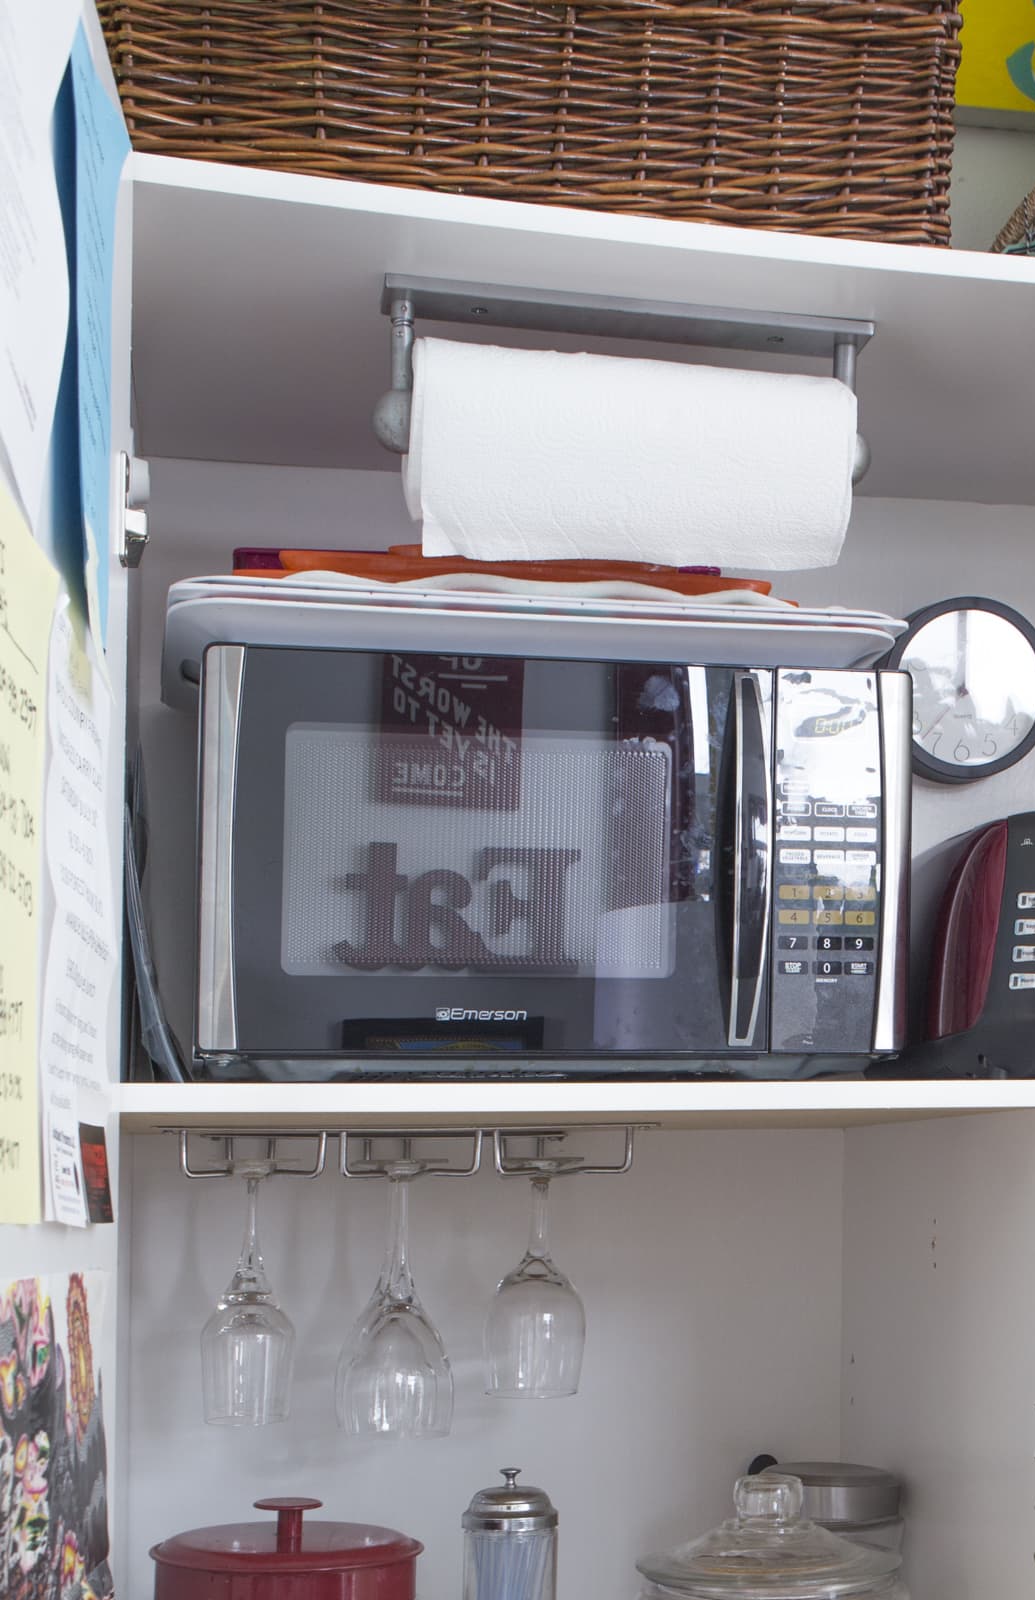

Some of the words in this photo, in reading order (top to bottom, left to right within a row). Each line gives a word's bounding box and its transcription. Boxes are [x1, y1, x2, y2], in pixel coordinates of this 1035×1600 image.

[931, 732, 943, 757] 7
[953, 739, 970, 762] 6
[981, 733, 997, 757] 5
[791, 887, 797, 898] 1
[790, 912, 798, 923] 4
[825, 913, 831, 924] 5
[856, 914, 863, 924] 6
[789, 937, 797, 949] 7
[823, 938, 831, 950] 8
[855, 938, 863, 950] 9
[823, 962, 830, 974] 0
[450, 1007, 528, 1022] Emerson
